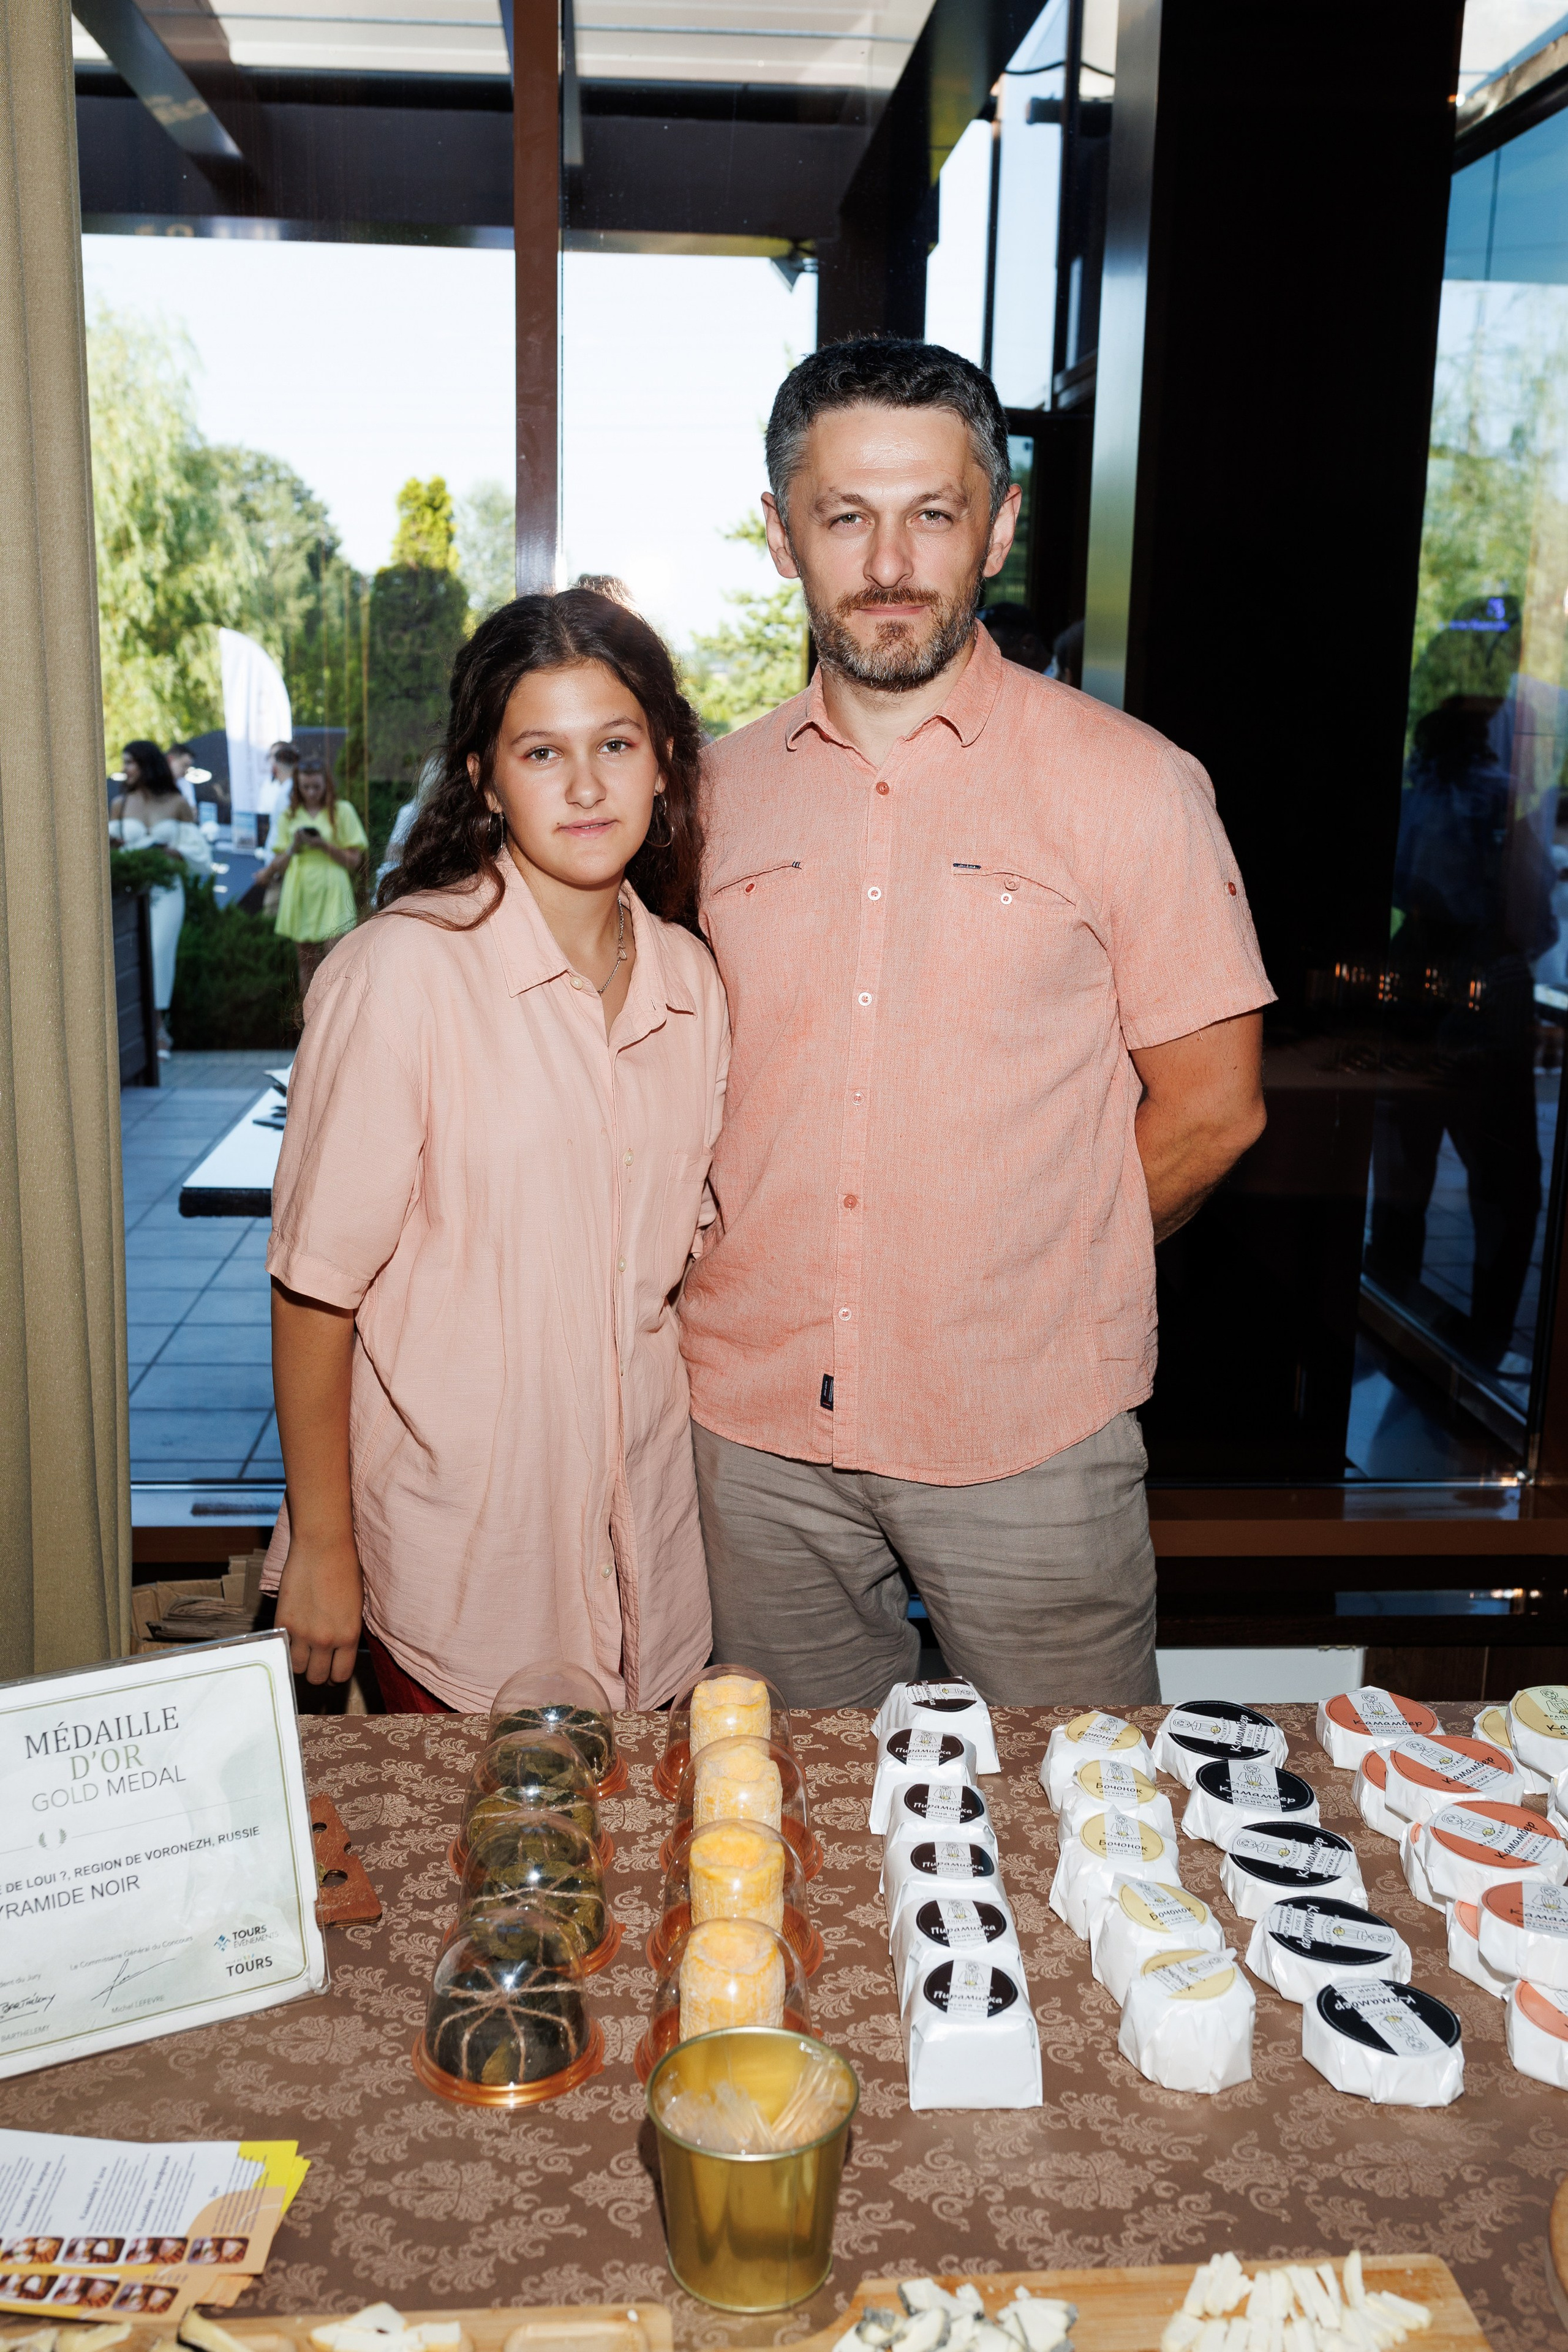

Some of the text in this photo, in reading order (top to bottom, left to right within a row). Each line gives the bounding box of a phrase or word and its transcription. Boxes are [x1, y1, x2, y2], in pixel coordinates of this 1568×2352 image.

[24, 1706, 179, 1759] MÉDAILLE
[1077, 1730, 1121, 1743] Бочонок
[1230, 1715, 1253, 1752] Камамбер
[1442, 1756, 1496, 1785] Камамбер
[32, 1765, 186, 1811] GOLD MEDAL
[1096, 1782, 1143, 1794] Бочонок
[1219, 1785, 1295, 1804] Камамбер
[914, 1803, 973, 1814] Пирамидка
[1099, 1839, 1148, 1852] Бочонок
[1494, 1820, 1539, 1860] Камамбер
[6, 1880, 23, 1893] DE
[26, 1873, 56, 1888] LOUI
[74, 1858, 122, 1878] REGION
[126, 1853, 141, 1866] DE
[145, 1838, 215, 1861] VORONEZH,
[217, 1826, 260, 1844] RUSSIE
[922, 1861, 984, 1871] Пирамидка
[1296, 1836, 1328, 1879] Камамбер
[91, 1875, 140, 1900] NOIR
[1149, 1907, 1196, 1921] Бочонок
[232, 1924, 267, 1940] TOURS
[931, 1924, 997, 1935] Пирамидка
[1296, 1904, 1320, 1950] Камамбер
[226, 1956, 273, 1977] TOURS
[933, 1991, 1003, 2004] Пирамидка
[1335, 1994, 1417, 2011] Камамбер
